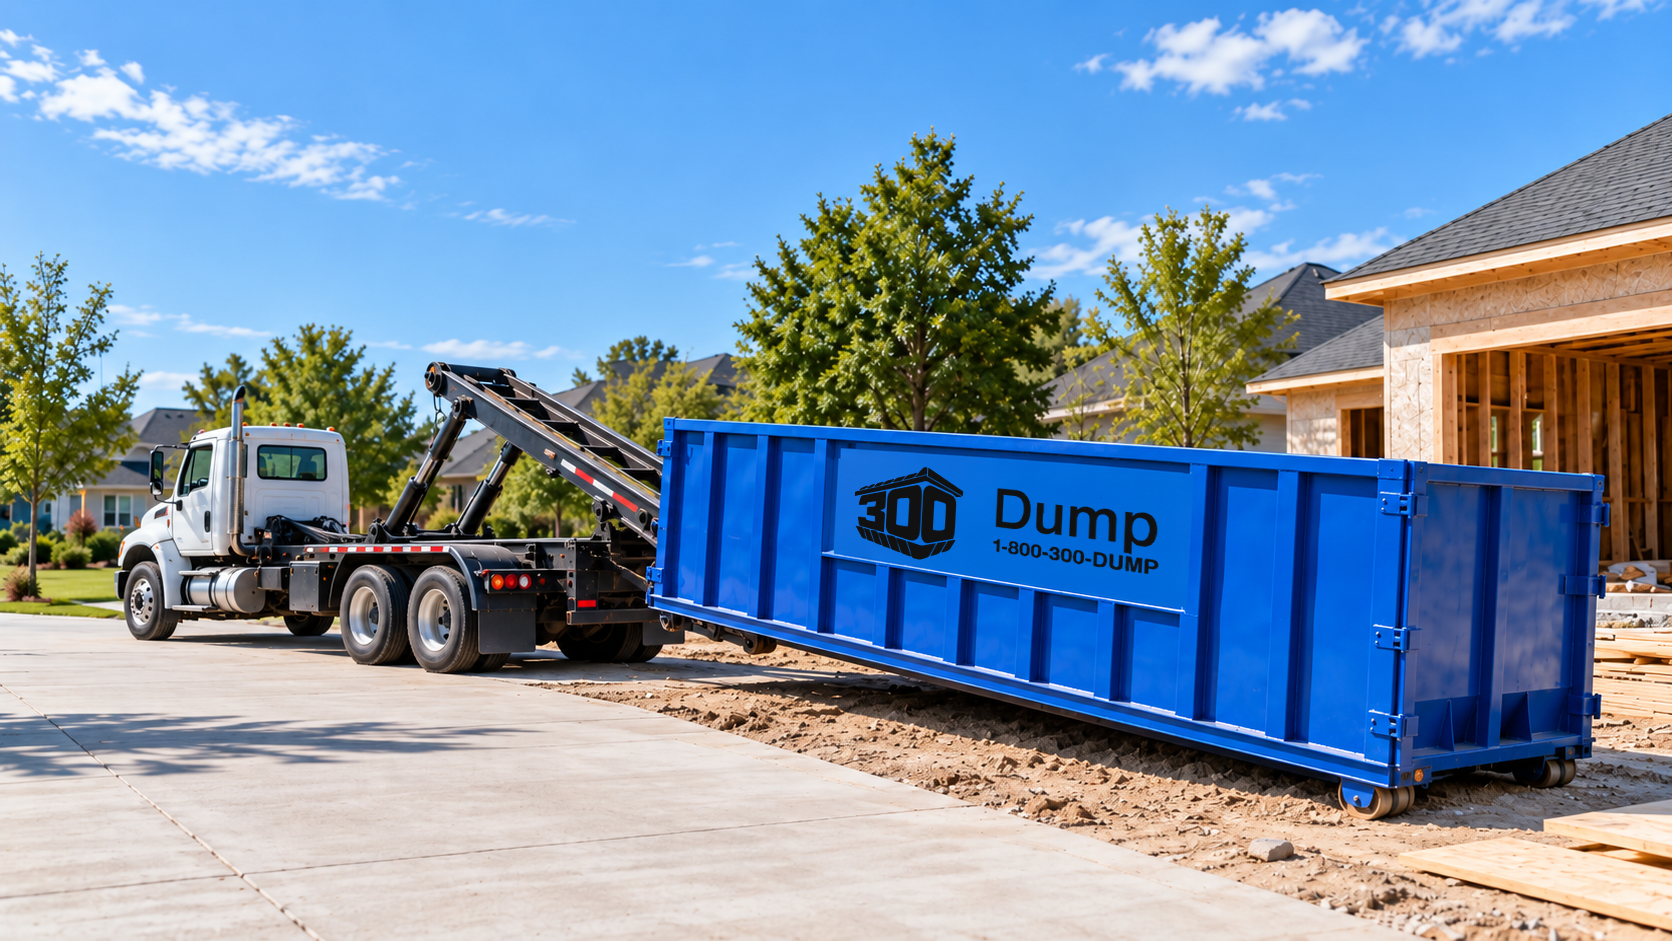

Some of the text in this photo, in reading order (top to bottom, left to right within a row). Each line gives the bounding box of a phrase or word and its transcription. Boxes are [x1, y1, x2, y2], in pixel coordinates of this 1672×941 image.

[858, 485, 1158, 554] 300 Dump
[993, 539, 1159, 574] 1-800-300-DUMP
